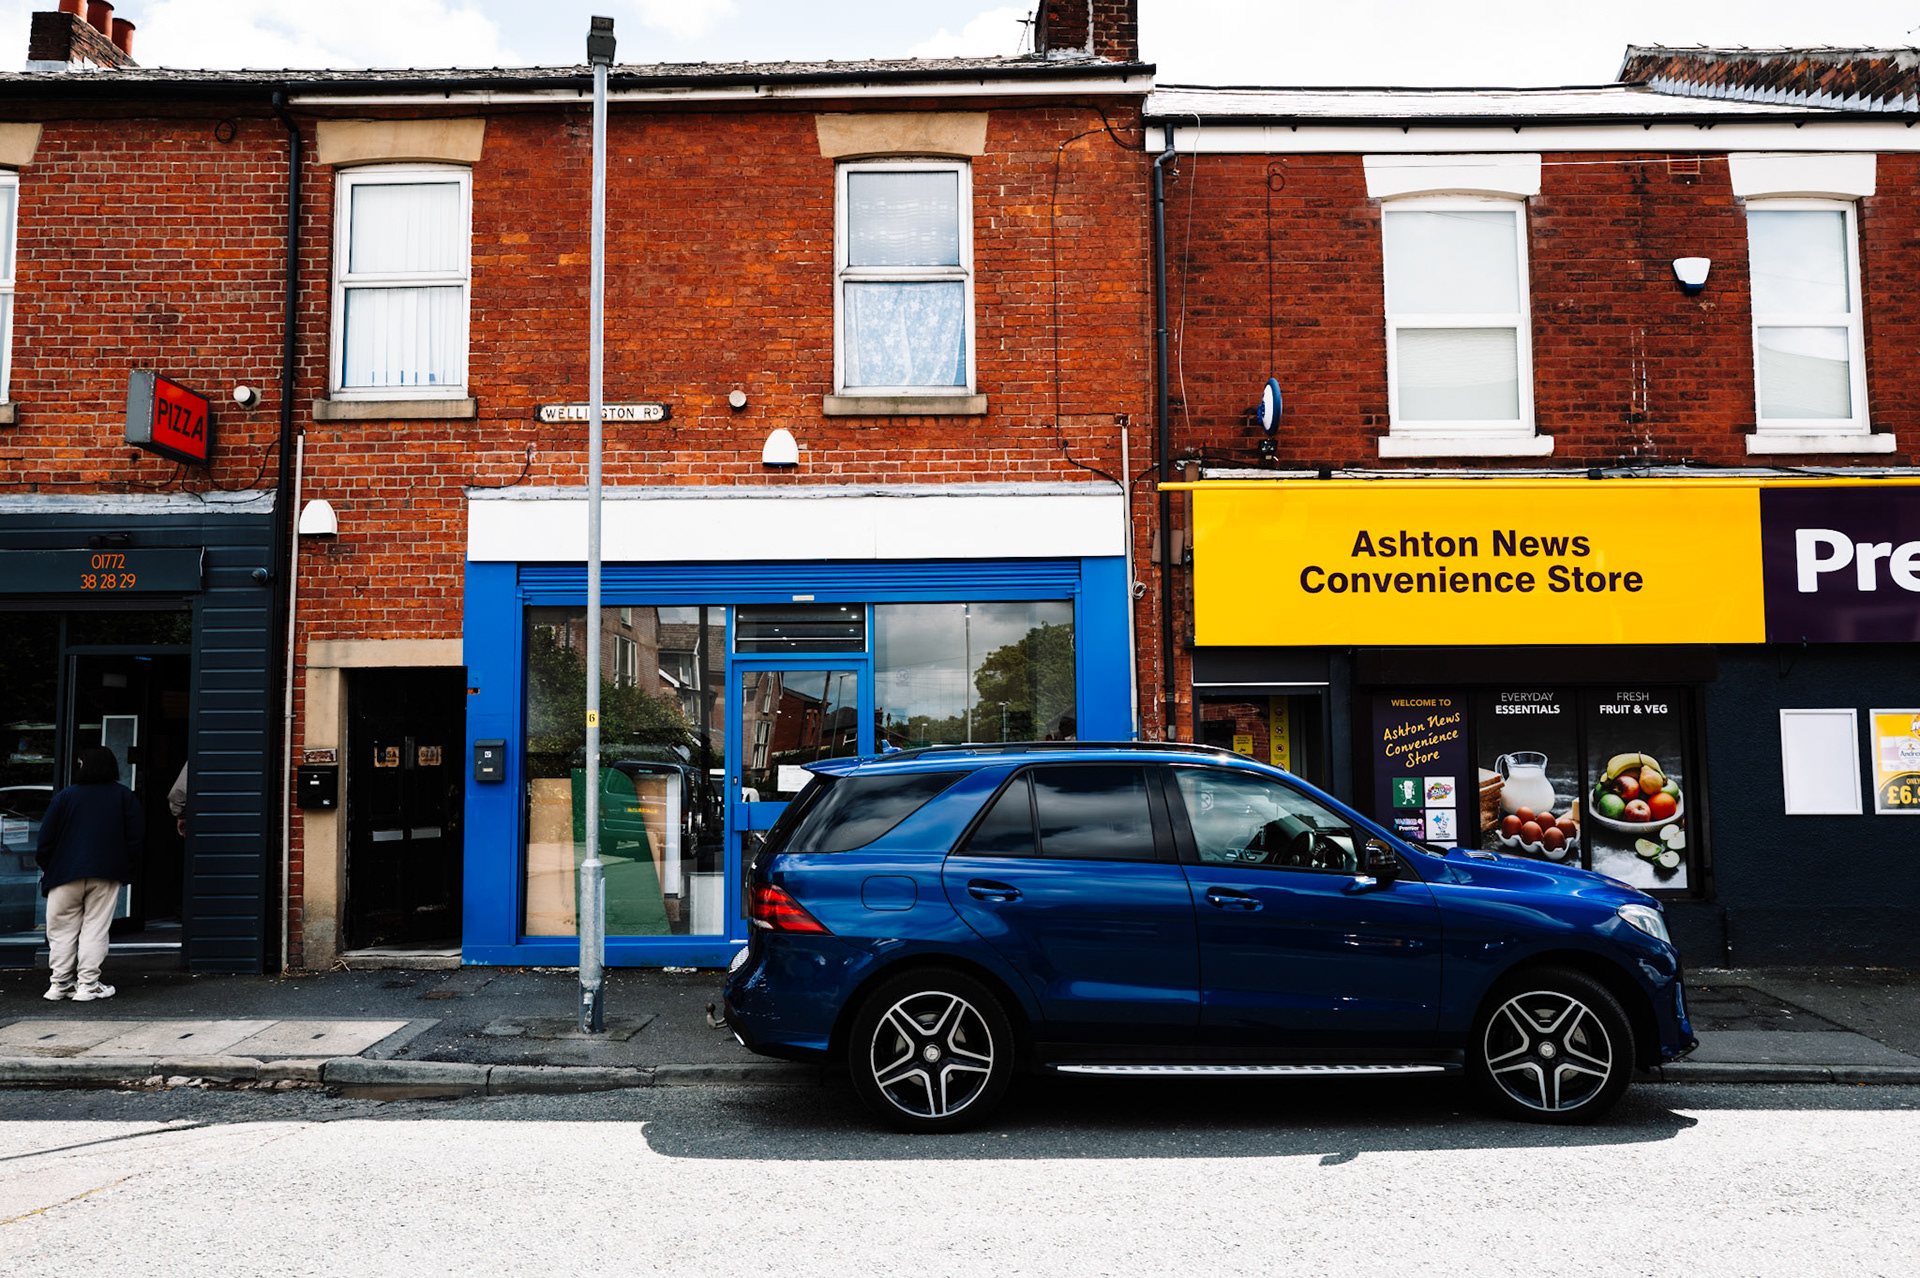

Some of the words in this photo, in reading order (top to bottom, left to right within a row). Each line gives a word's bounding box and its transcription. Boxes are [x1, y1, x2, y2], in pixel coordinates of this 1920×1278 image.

[157, 398, 204, 442] PIZZA
[545, 408, 635, 419] WELLIGTON
[1351, 530, 1478, 557] Ashton
[1493, 530, 1590, 557] News
[91, 554, 125, 569] 01772
[1795, 528, 1920, 593] Pre
[80, 574, 97, 589] 38
[100, 573, 116, 589] 28
[120, 573, 136, 588] 29
[1300, 565, 1535, 593] Convenience
[1548, 565, 1643, 592] Store
[1391, 699, 1437, 707] WELCOME
[1501, 692, 1554, 702] EVERYDAY
[1616, 691, 1649, 701] FRESH
[1495, 704, 1560, 714] ESSENTIALS
[1599, 704, 1631, 714] FRUIT
[1633, 704, 1642, 714] &
[1644, 704, 1668, 714] VEG
[1383, 721, 1425, 741] Ashton
[1427, 712, 1460, 728] News
[1385, 729, 1459, 757] Convenience
[1405, 751, 1440, 768] Store
[1887, 785, 1920, 804] £6.
